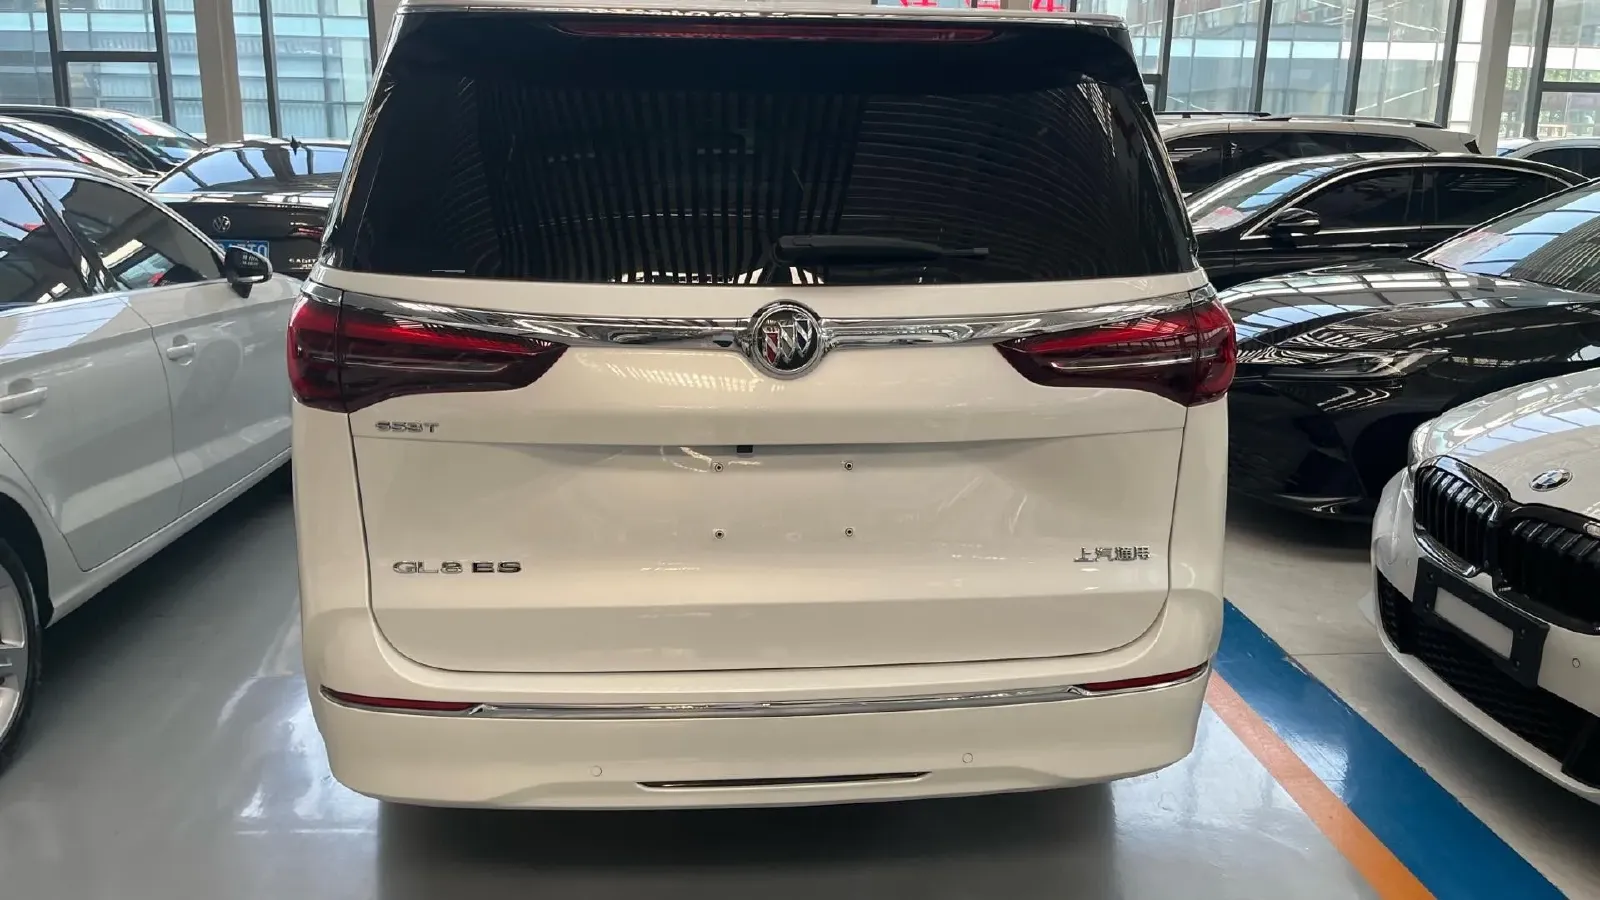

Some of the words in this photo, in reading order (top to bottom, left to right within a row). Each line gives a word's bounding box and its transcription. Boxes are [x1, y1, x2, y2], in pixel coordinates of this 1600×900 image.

[1073, 546, 1151, 562] 上汽通用
[392, 561, 464, 574] GL8
[471, 561, 522, 574] ES
